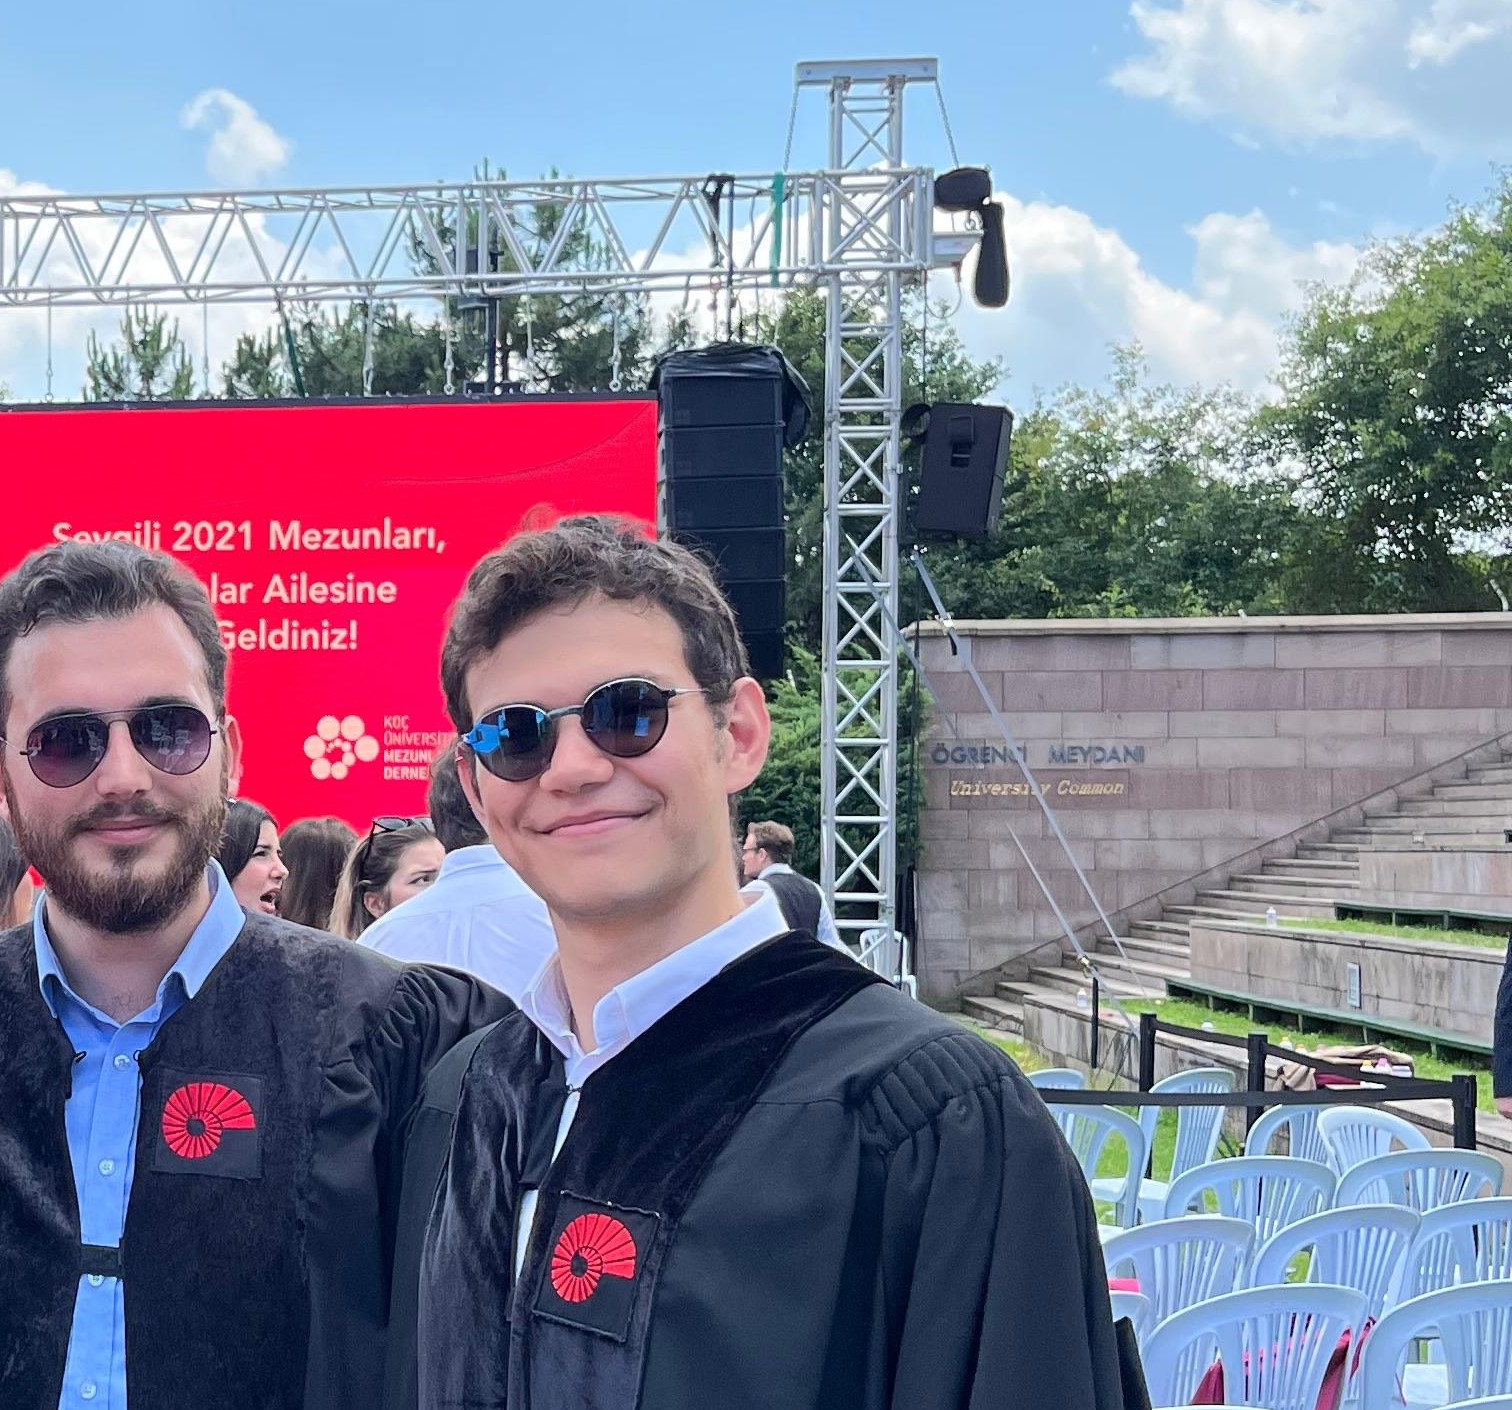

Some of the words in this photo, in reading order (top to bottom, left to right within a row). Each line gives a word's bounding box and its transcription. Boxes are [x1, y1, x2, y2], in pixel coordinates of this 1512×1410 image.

[172, 519, 252, 552] 2021
[269, 516, 446, 554] Mezunları,
[262, 571, 398, 605] Ailesine
[219, 618, 358, 651] Geldiniz!
[383, 714, 408, 731] KOÇ
[383, 748, 433, 764] MEZUNL
[1048, 745, 1144, 763] MEYDANI
[383, 765, 430, 780] DERNE
[951, 780, 1051, 796] Universiy
[1057, 780, 1125, 796] Common
